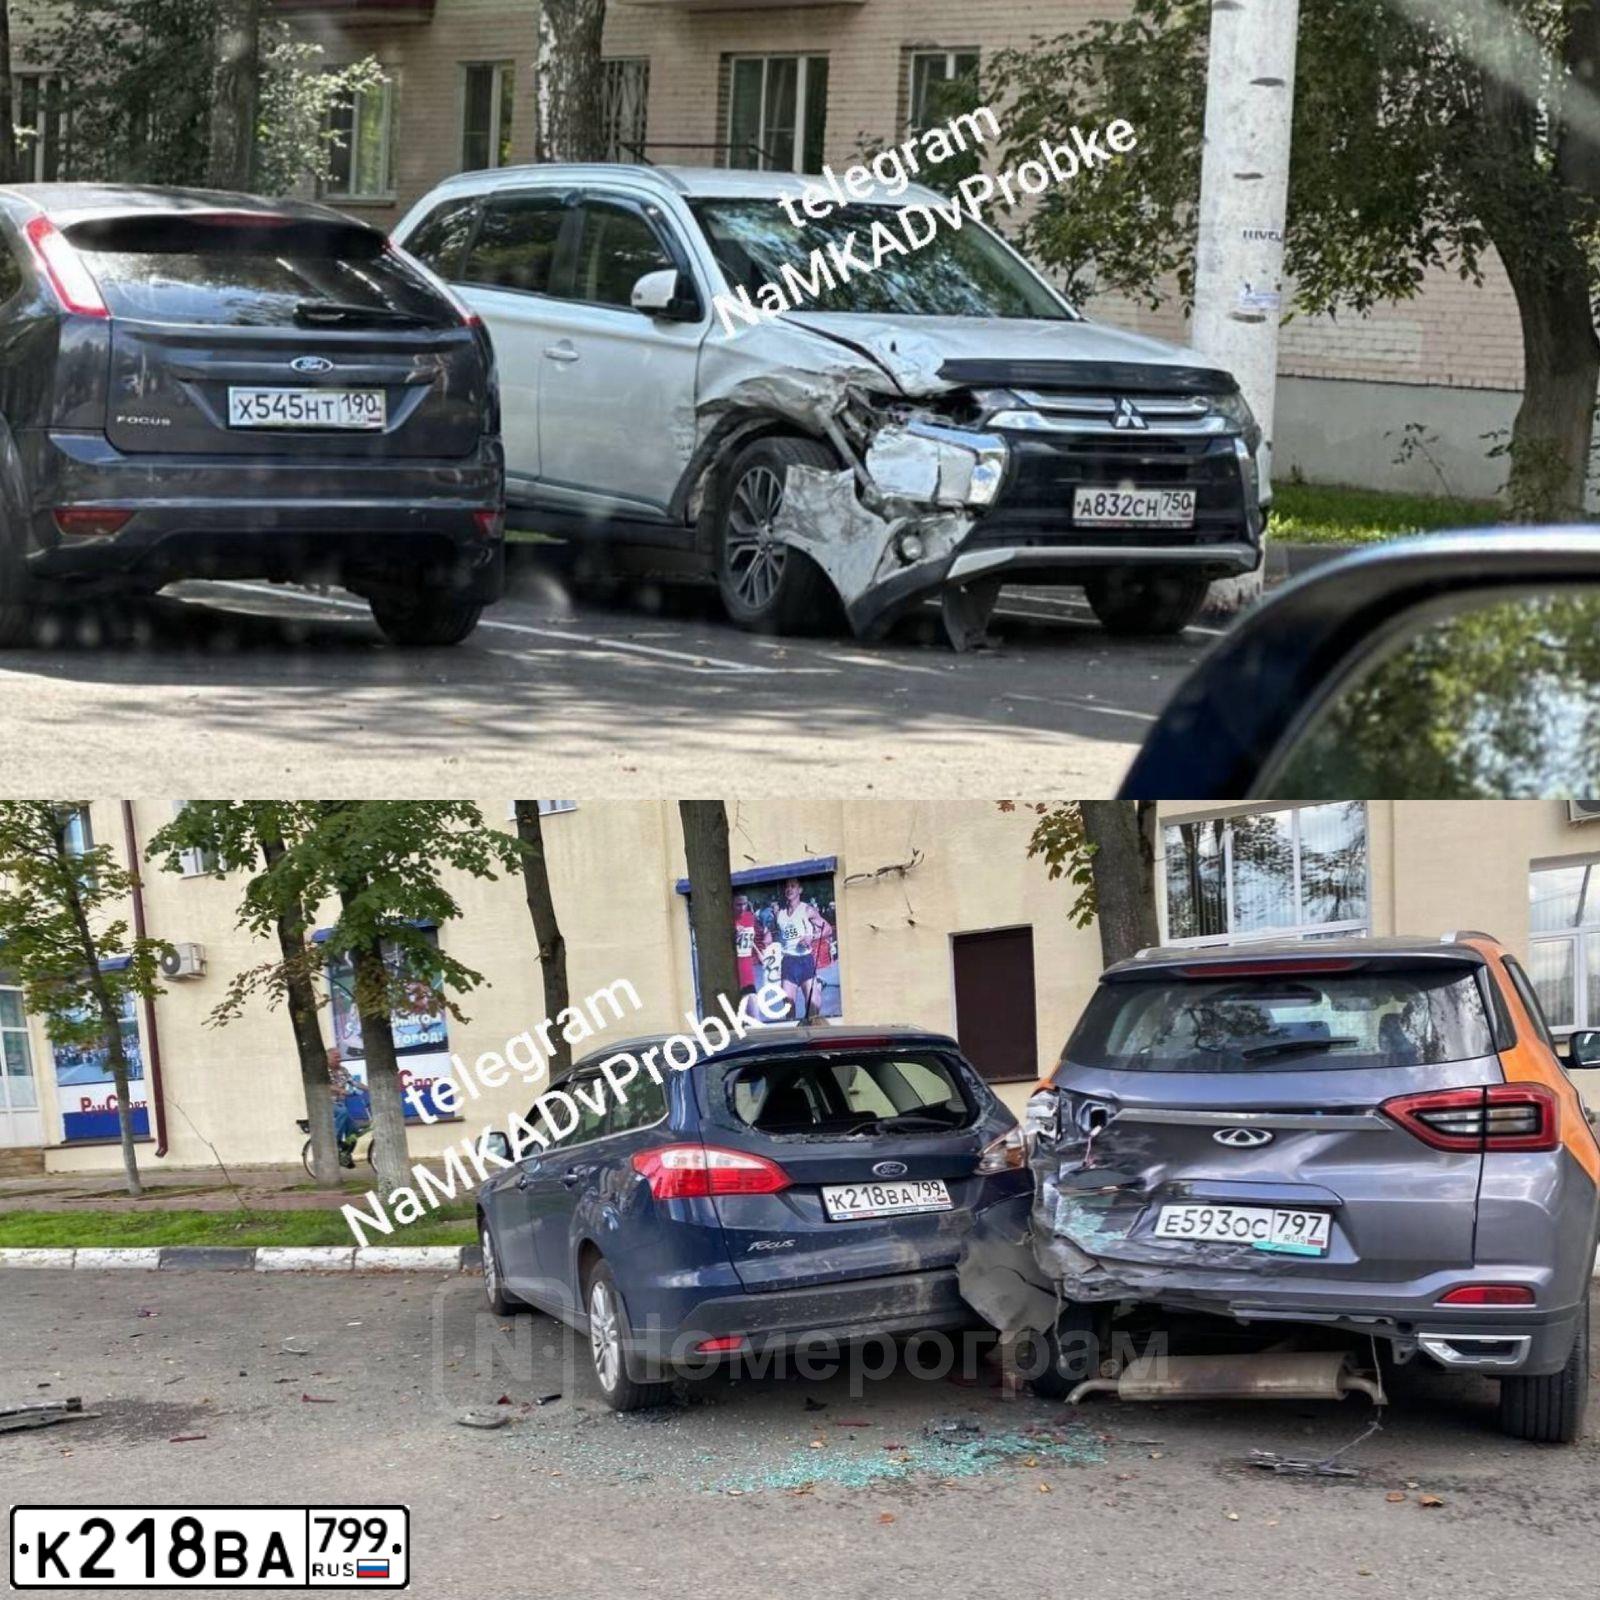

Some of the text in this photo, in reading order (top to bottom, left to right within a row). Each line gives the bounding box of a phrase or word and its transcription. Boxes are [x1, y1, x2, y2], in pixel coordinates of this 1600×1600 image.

[238, 393, 377, 420] Х545НТ 190
[116, 415, 172, 426] FOCUS
[1080, 492, 1192, 517] А832СН 750
[831, 1181, 941, 1211] К218ВА 799
[1163, 1209, 1323, 1239] Е593ОС 797
[1283, 1234, 1307, 1245] RUS
